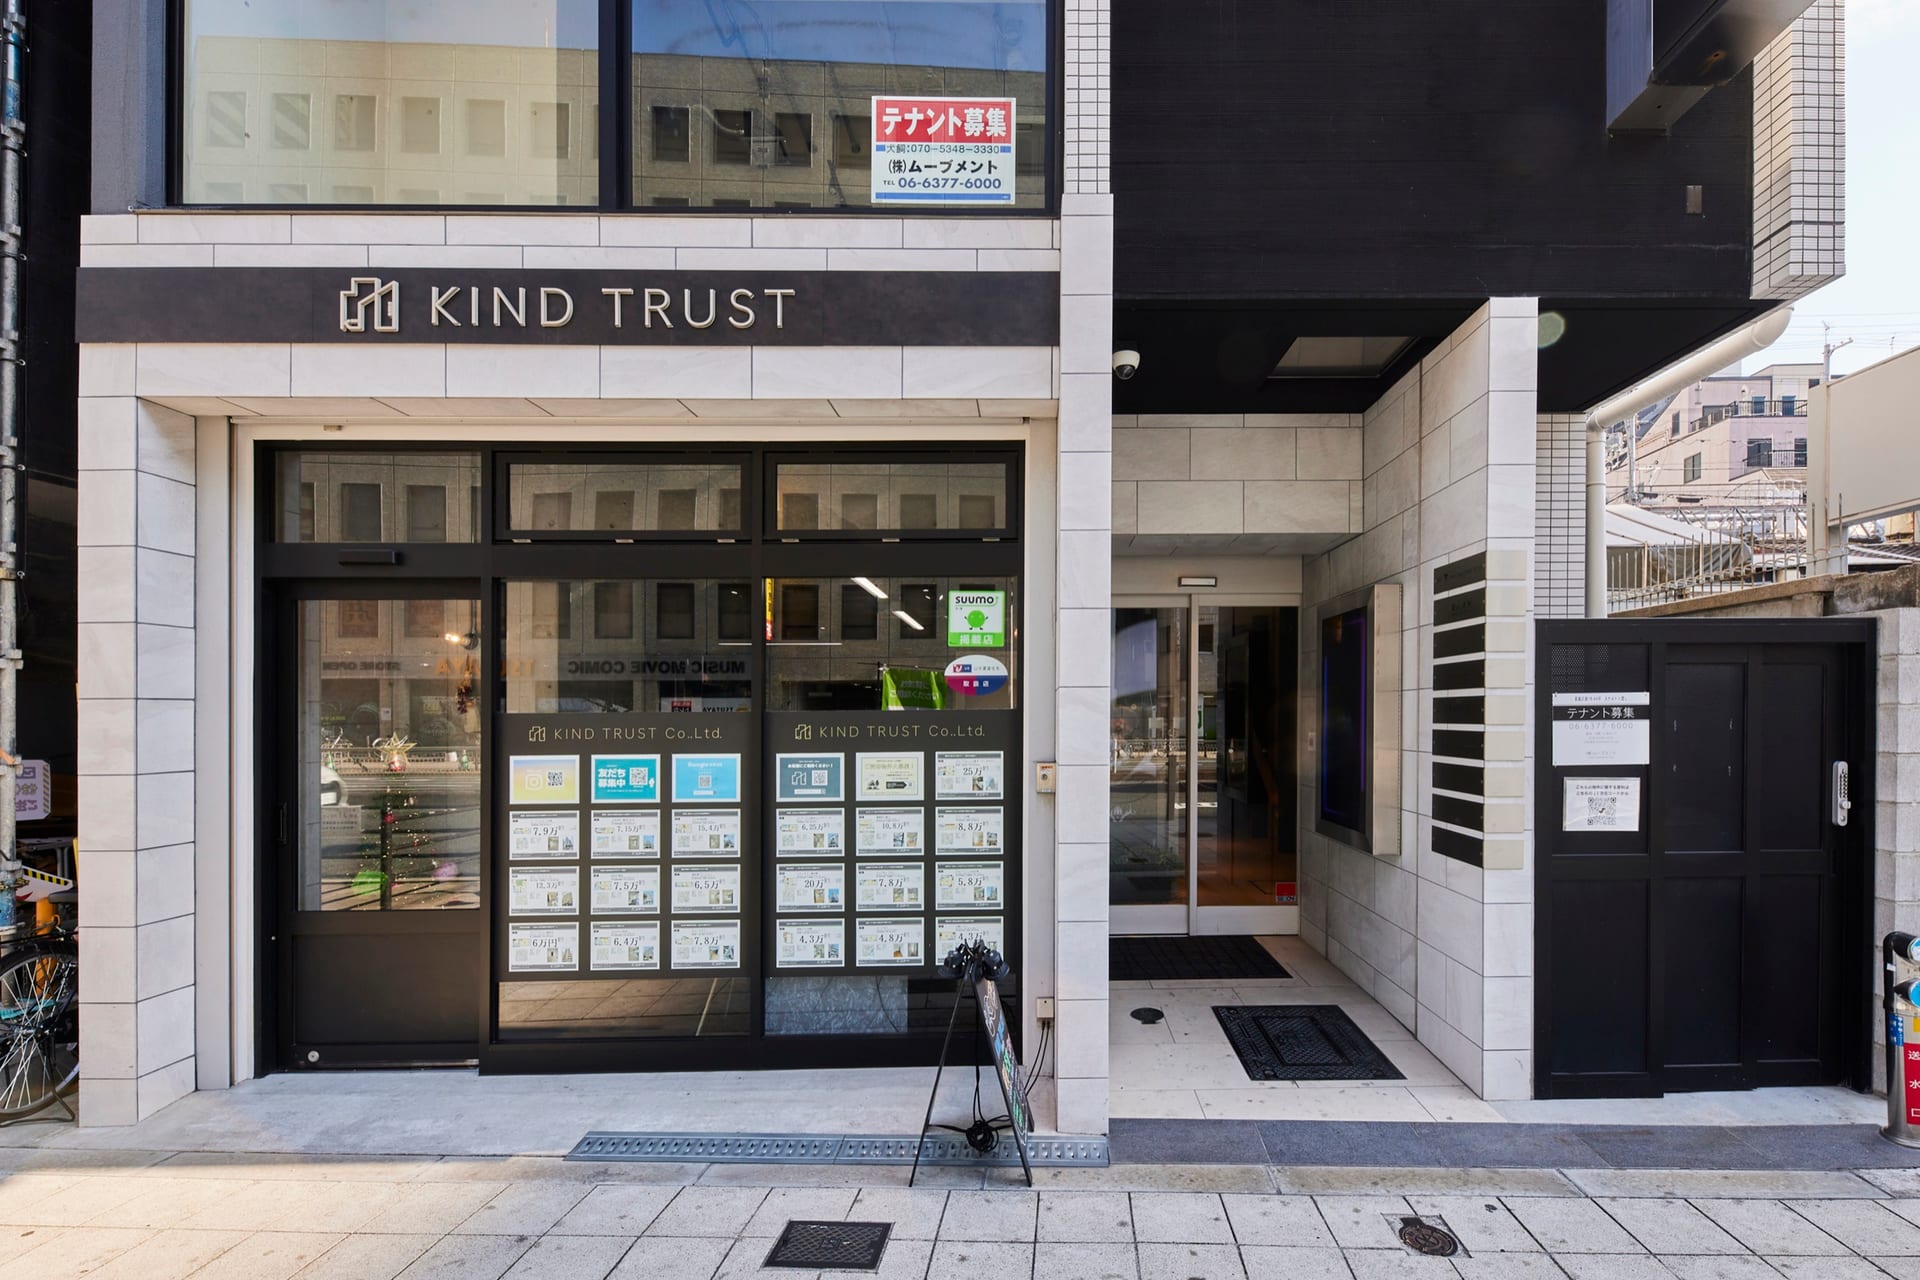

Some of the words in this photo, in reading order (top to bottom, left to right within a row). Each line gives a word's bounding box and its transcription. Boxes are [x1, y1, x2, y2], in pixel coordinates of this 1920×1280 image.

[882, 107, 1006, 137] テナント募集
[898, 178, 1001, 189] 06-6377-6000
[431, 286, 575, 328] KIND
[602, 288, 796, 328] TRUST
[1568, 707, 1634, 719] テナント募集
[554, 728, 595, 740] KIND
[602, 727, 656, 740] TRUST
[819, 726, 860, 738] KIND
[867, 725, 920, 737] TRUST
